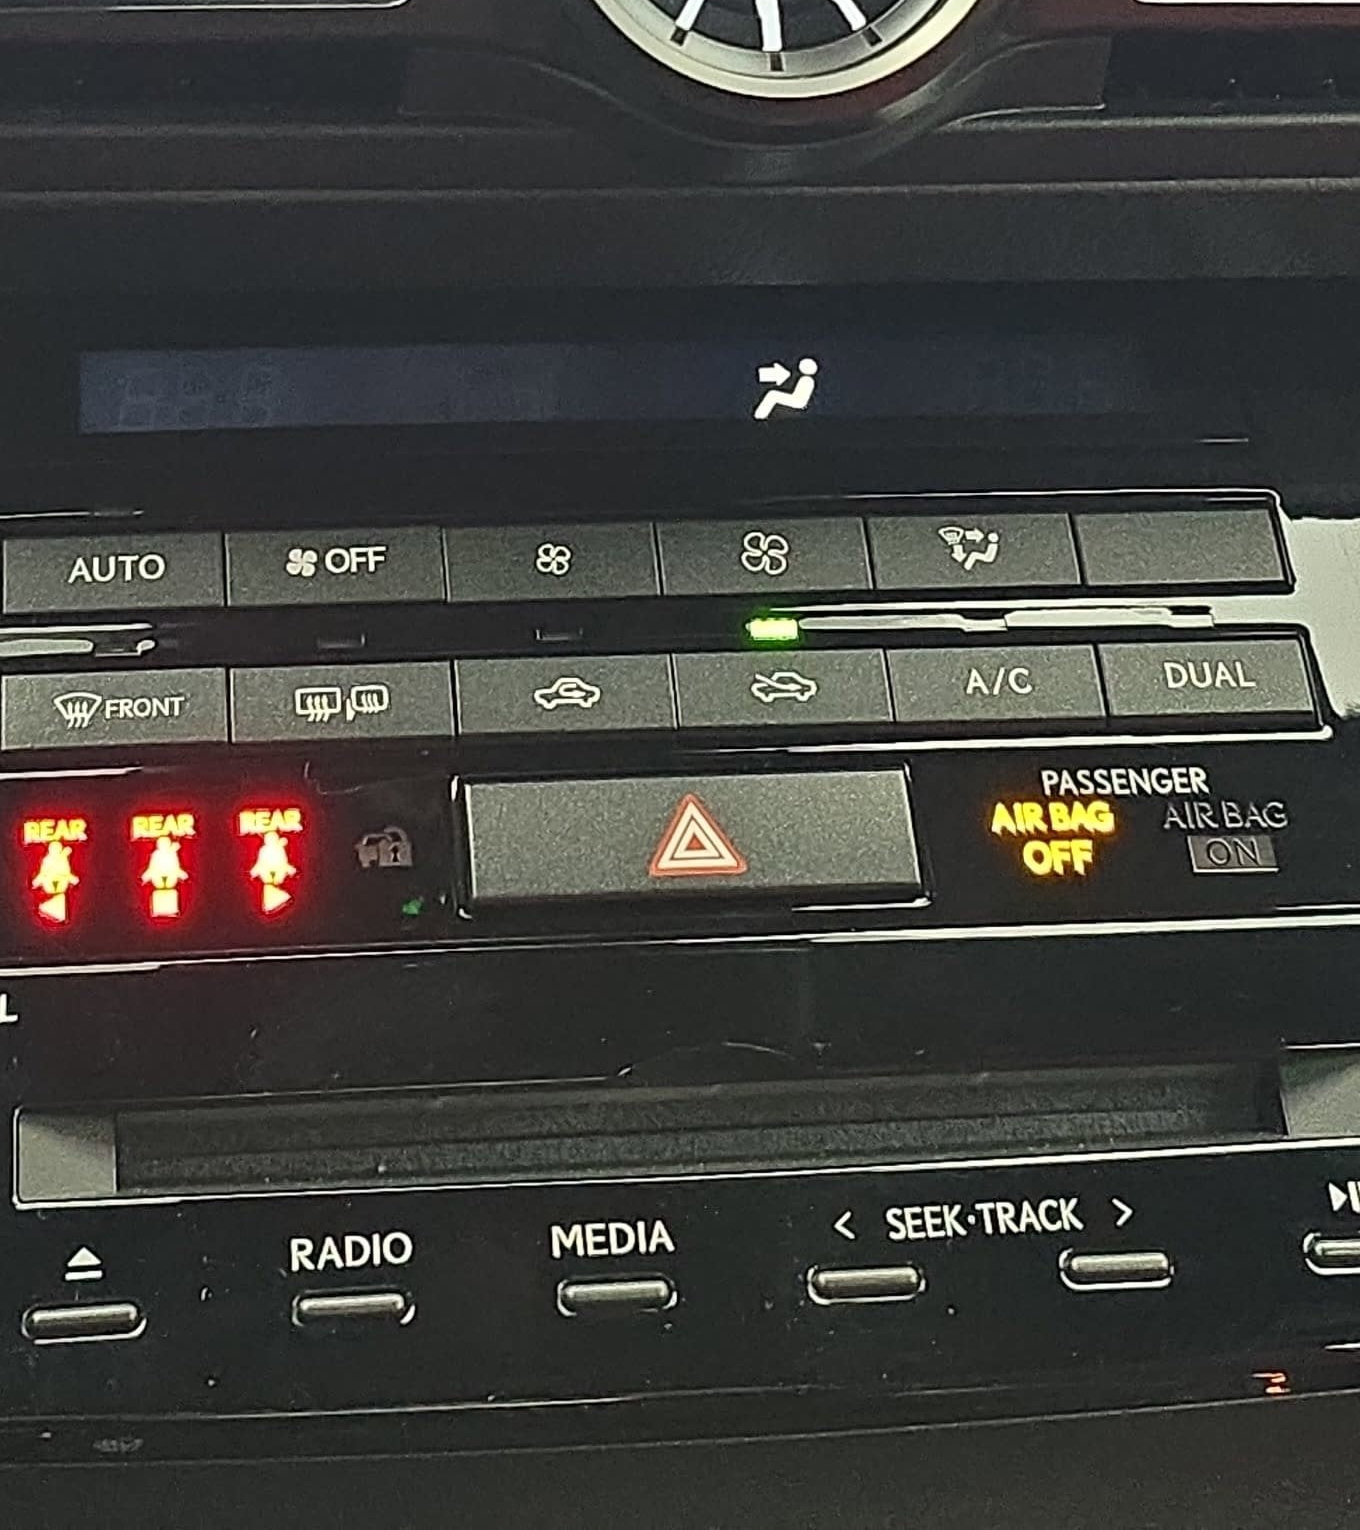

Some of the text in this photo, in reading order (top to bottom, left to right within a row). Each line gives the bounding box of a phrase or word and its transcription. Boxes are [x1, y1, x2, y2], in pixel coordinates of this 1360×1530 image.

[68, 553, 166, 584] AUTO
[325, 546, 387, 574] OFF
[965, 666, 1033, 695] A/C
[1163, 660, 1257, 689] DUAL
[105, 696, 186, 720] FRONT
[1041, 767, 1209, 796] PASSENGER
[131, 813, 196, 839] REAR
[240, 808, 304, 834] REAR
[990, 800, 1116, 836] AIR BAG
[1162, 801, 1289, 830] AIR BAG
[23, 818, 88, 845] REAR
[1022, 838, 1094, 876] OFF
[1206, 839, 1261, 867] ON
[289, 1231, 414, 1273] RADIO
[551, 1221, 676, 1257] MEDIA
